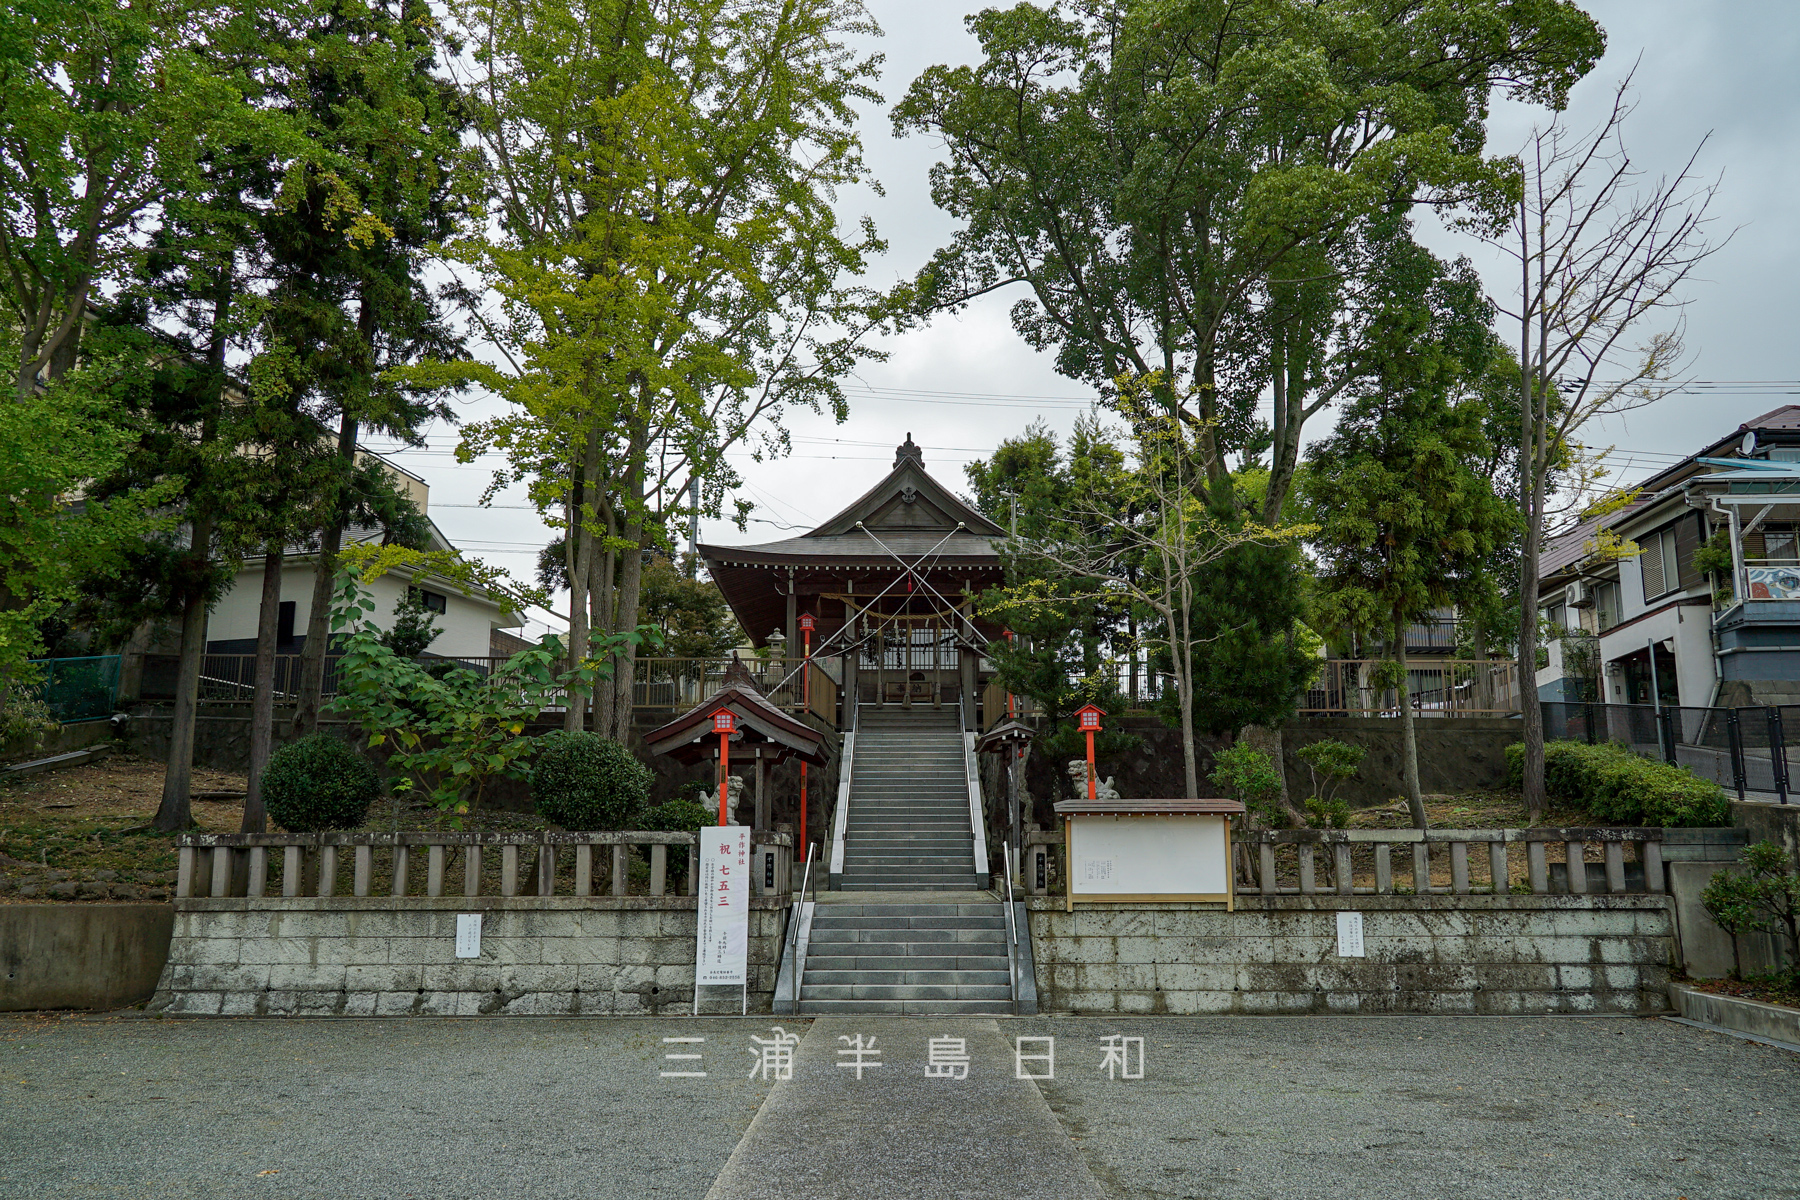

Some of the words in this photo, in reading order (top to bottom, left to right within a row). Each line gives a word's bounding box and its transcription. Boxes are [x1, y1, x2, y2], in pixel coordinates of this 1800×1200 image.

[719, 843, 731, 855] 祝
[737, 833, 746, 866] 平作神社
[718, 865, 730, 906] 七五三
